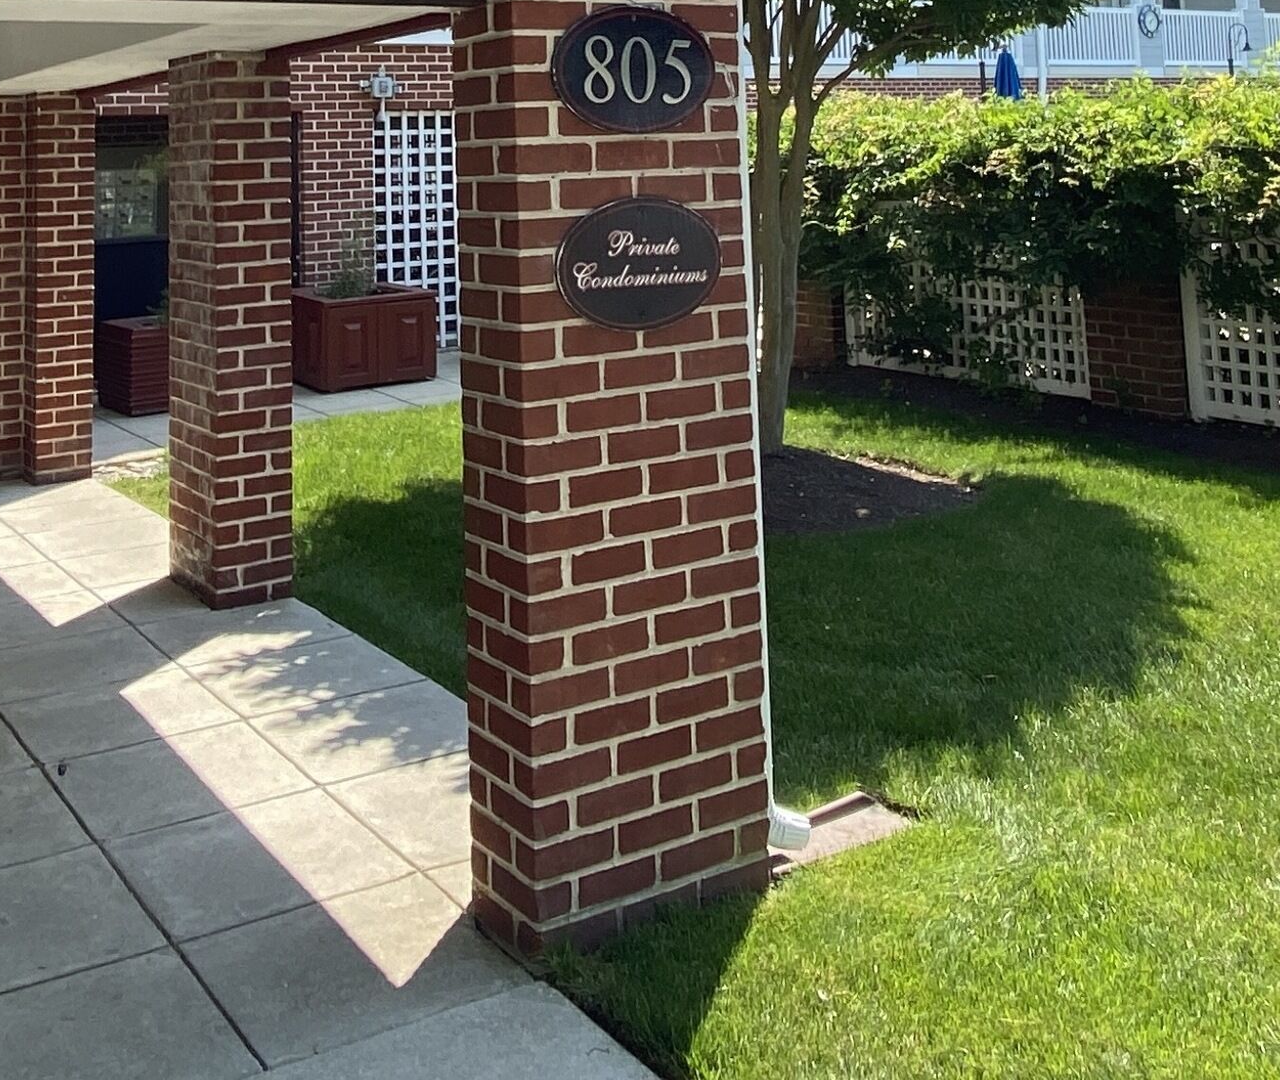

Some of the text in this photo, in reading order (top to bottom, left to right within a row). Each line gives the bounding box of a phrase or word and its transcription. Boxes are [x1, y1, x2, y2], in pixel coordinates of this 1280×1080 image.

[583, 34, 692, 105] 805
[607, 229, 681, 258] Private
[572, 261, 709, 291] Condominiums
